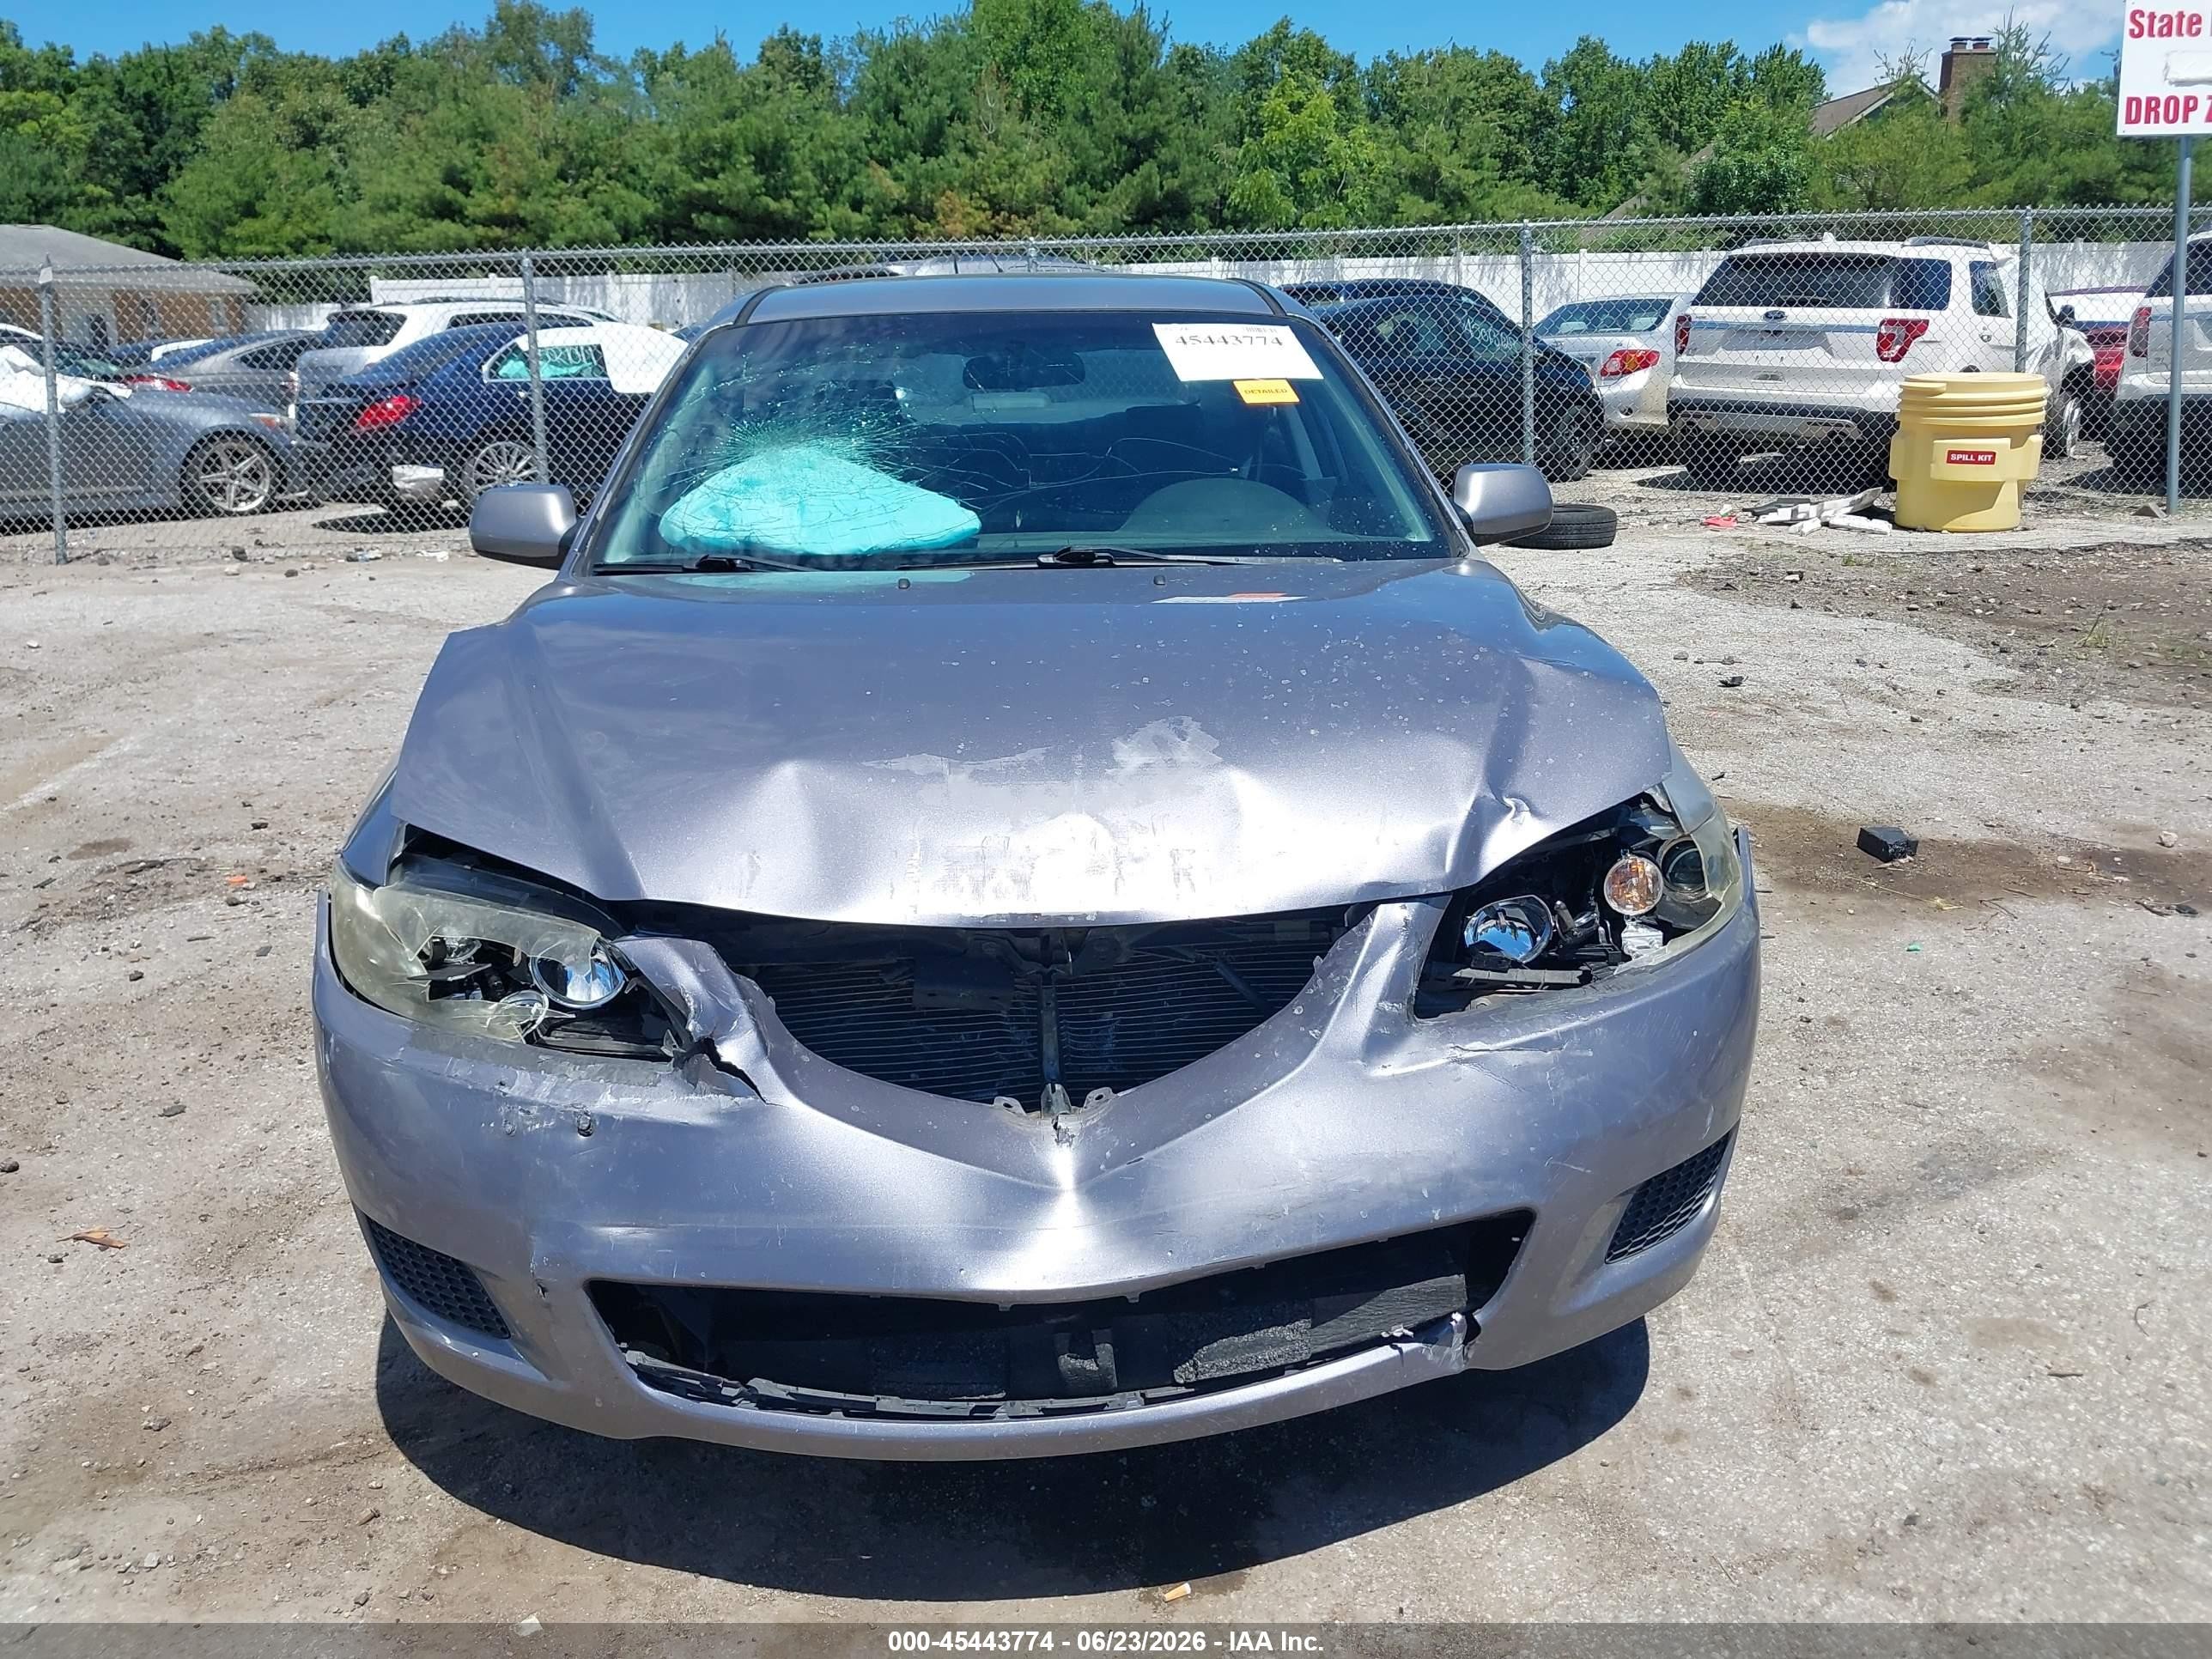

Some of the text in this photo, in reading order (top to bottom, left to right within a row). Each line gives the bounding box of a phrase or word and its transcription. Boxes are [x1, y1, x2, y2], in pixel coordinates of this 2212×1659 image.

[2129, 9, 2203, 39] State
[2124, 95, 2198, 125] DROP
[1175, 335, 1284, 346] 45443774
